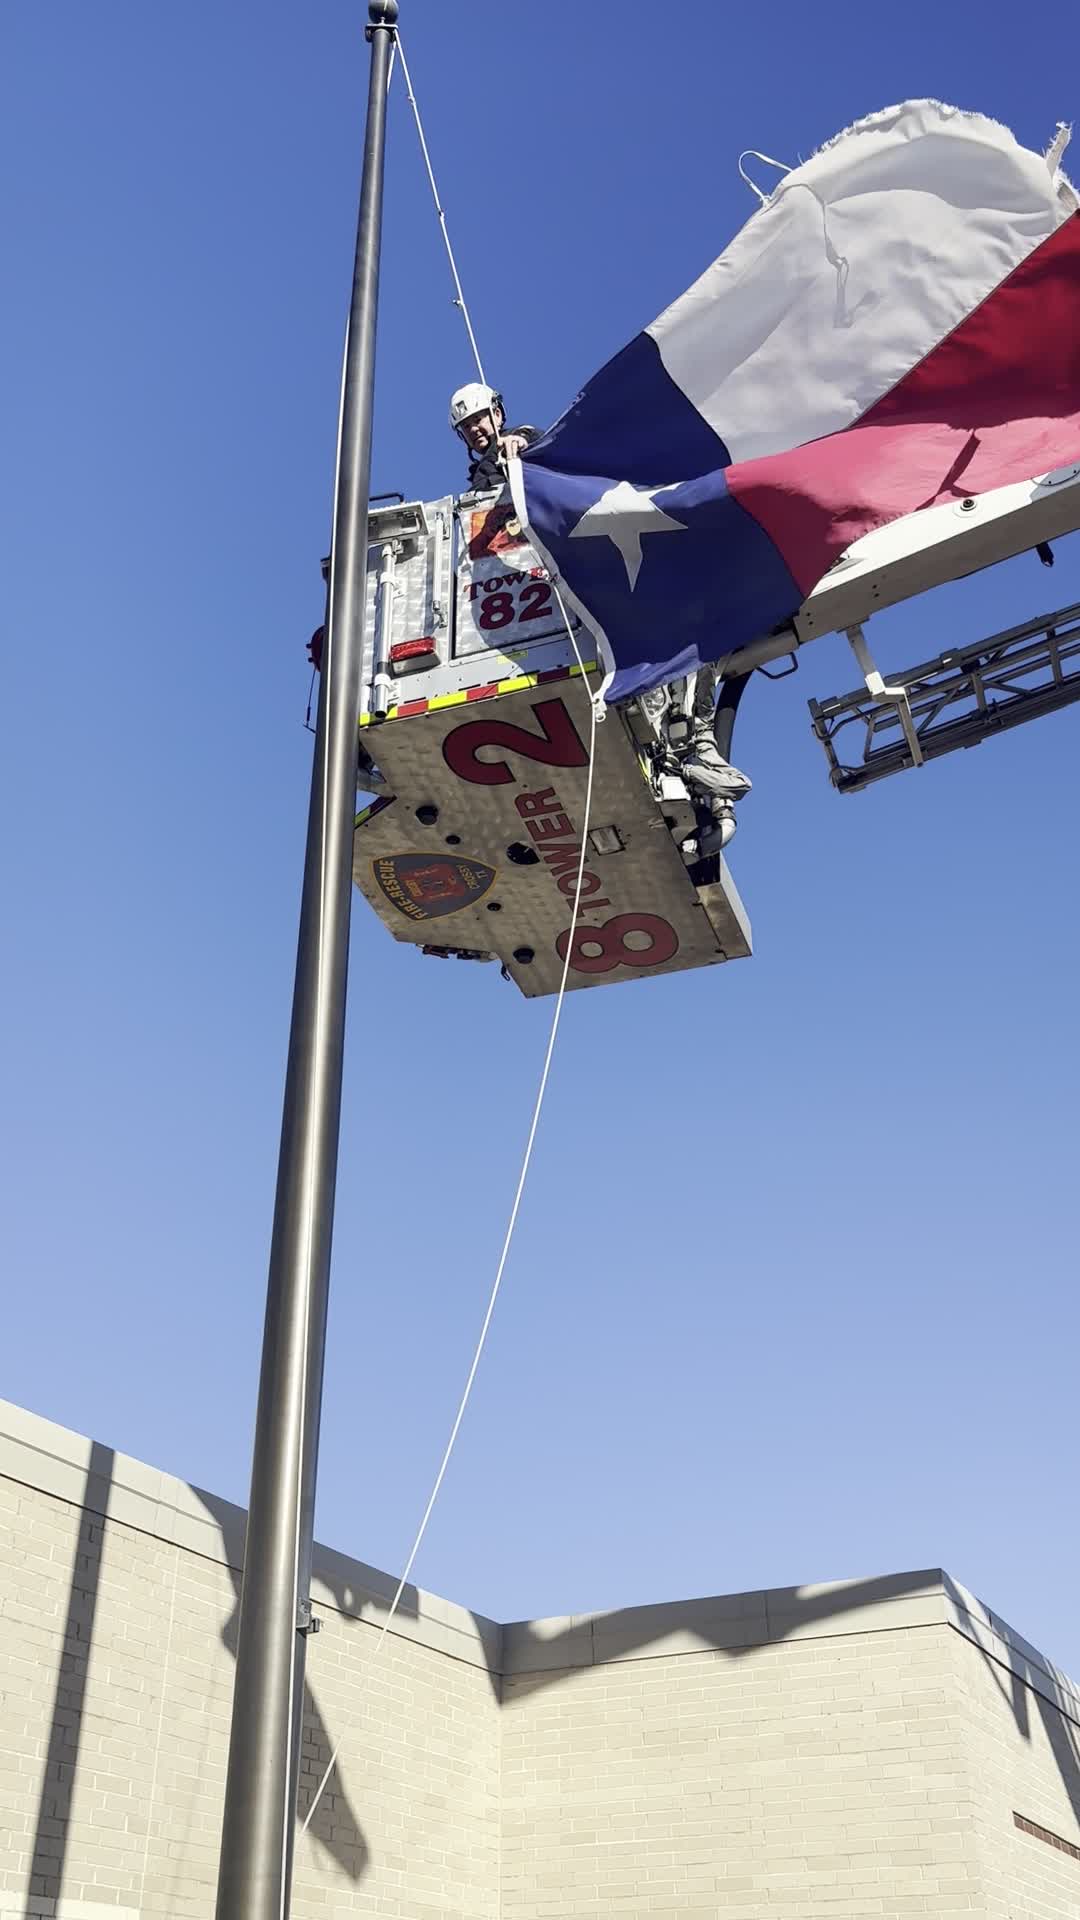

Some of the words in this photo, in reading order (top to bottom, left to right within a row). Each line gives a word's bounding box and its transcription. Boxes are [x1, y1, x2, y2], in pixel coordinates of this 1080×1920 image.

[464, 568, 559, 602] TOWE
[479, 583, 552, 630] 82
[442, 697, 591, 785] 2
[514, 786, 611, 918] TOWER
[556, 912, 679, 973] 8
